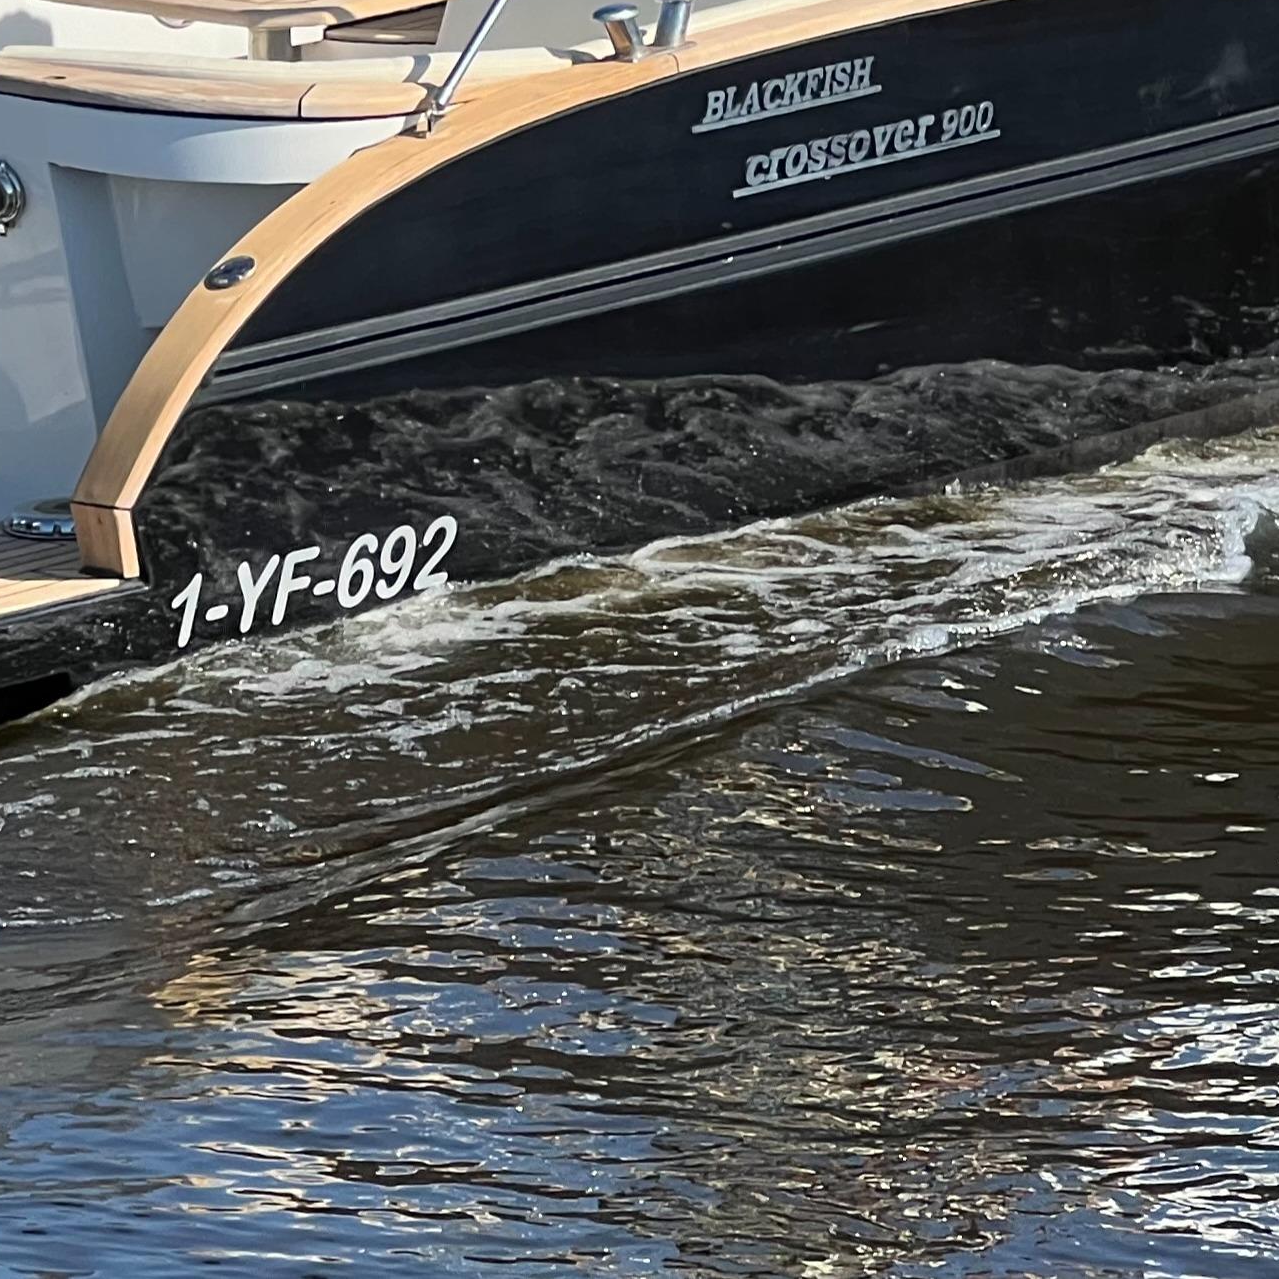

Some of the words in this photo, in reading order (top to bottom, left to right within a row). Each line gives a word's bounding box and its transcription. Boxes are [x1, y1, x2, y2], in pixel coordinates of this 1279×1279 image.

[703, 56, 875, 123] BLACKFISH
[941, 100, 994, 142] 900
[172, 515, 458, 648] 1-YF-692
